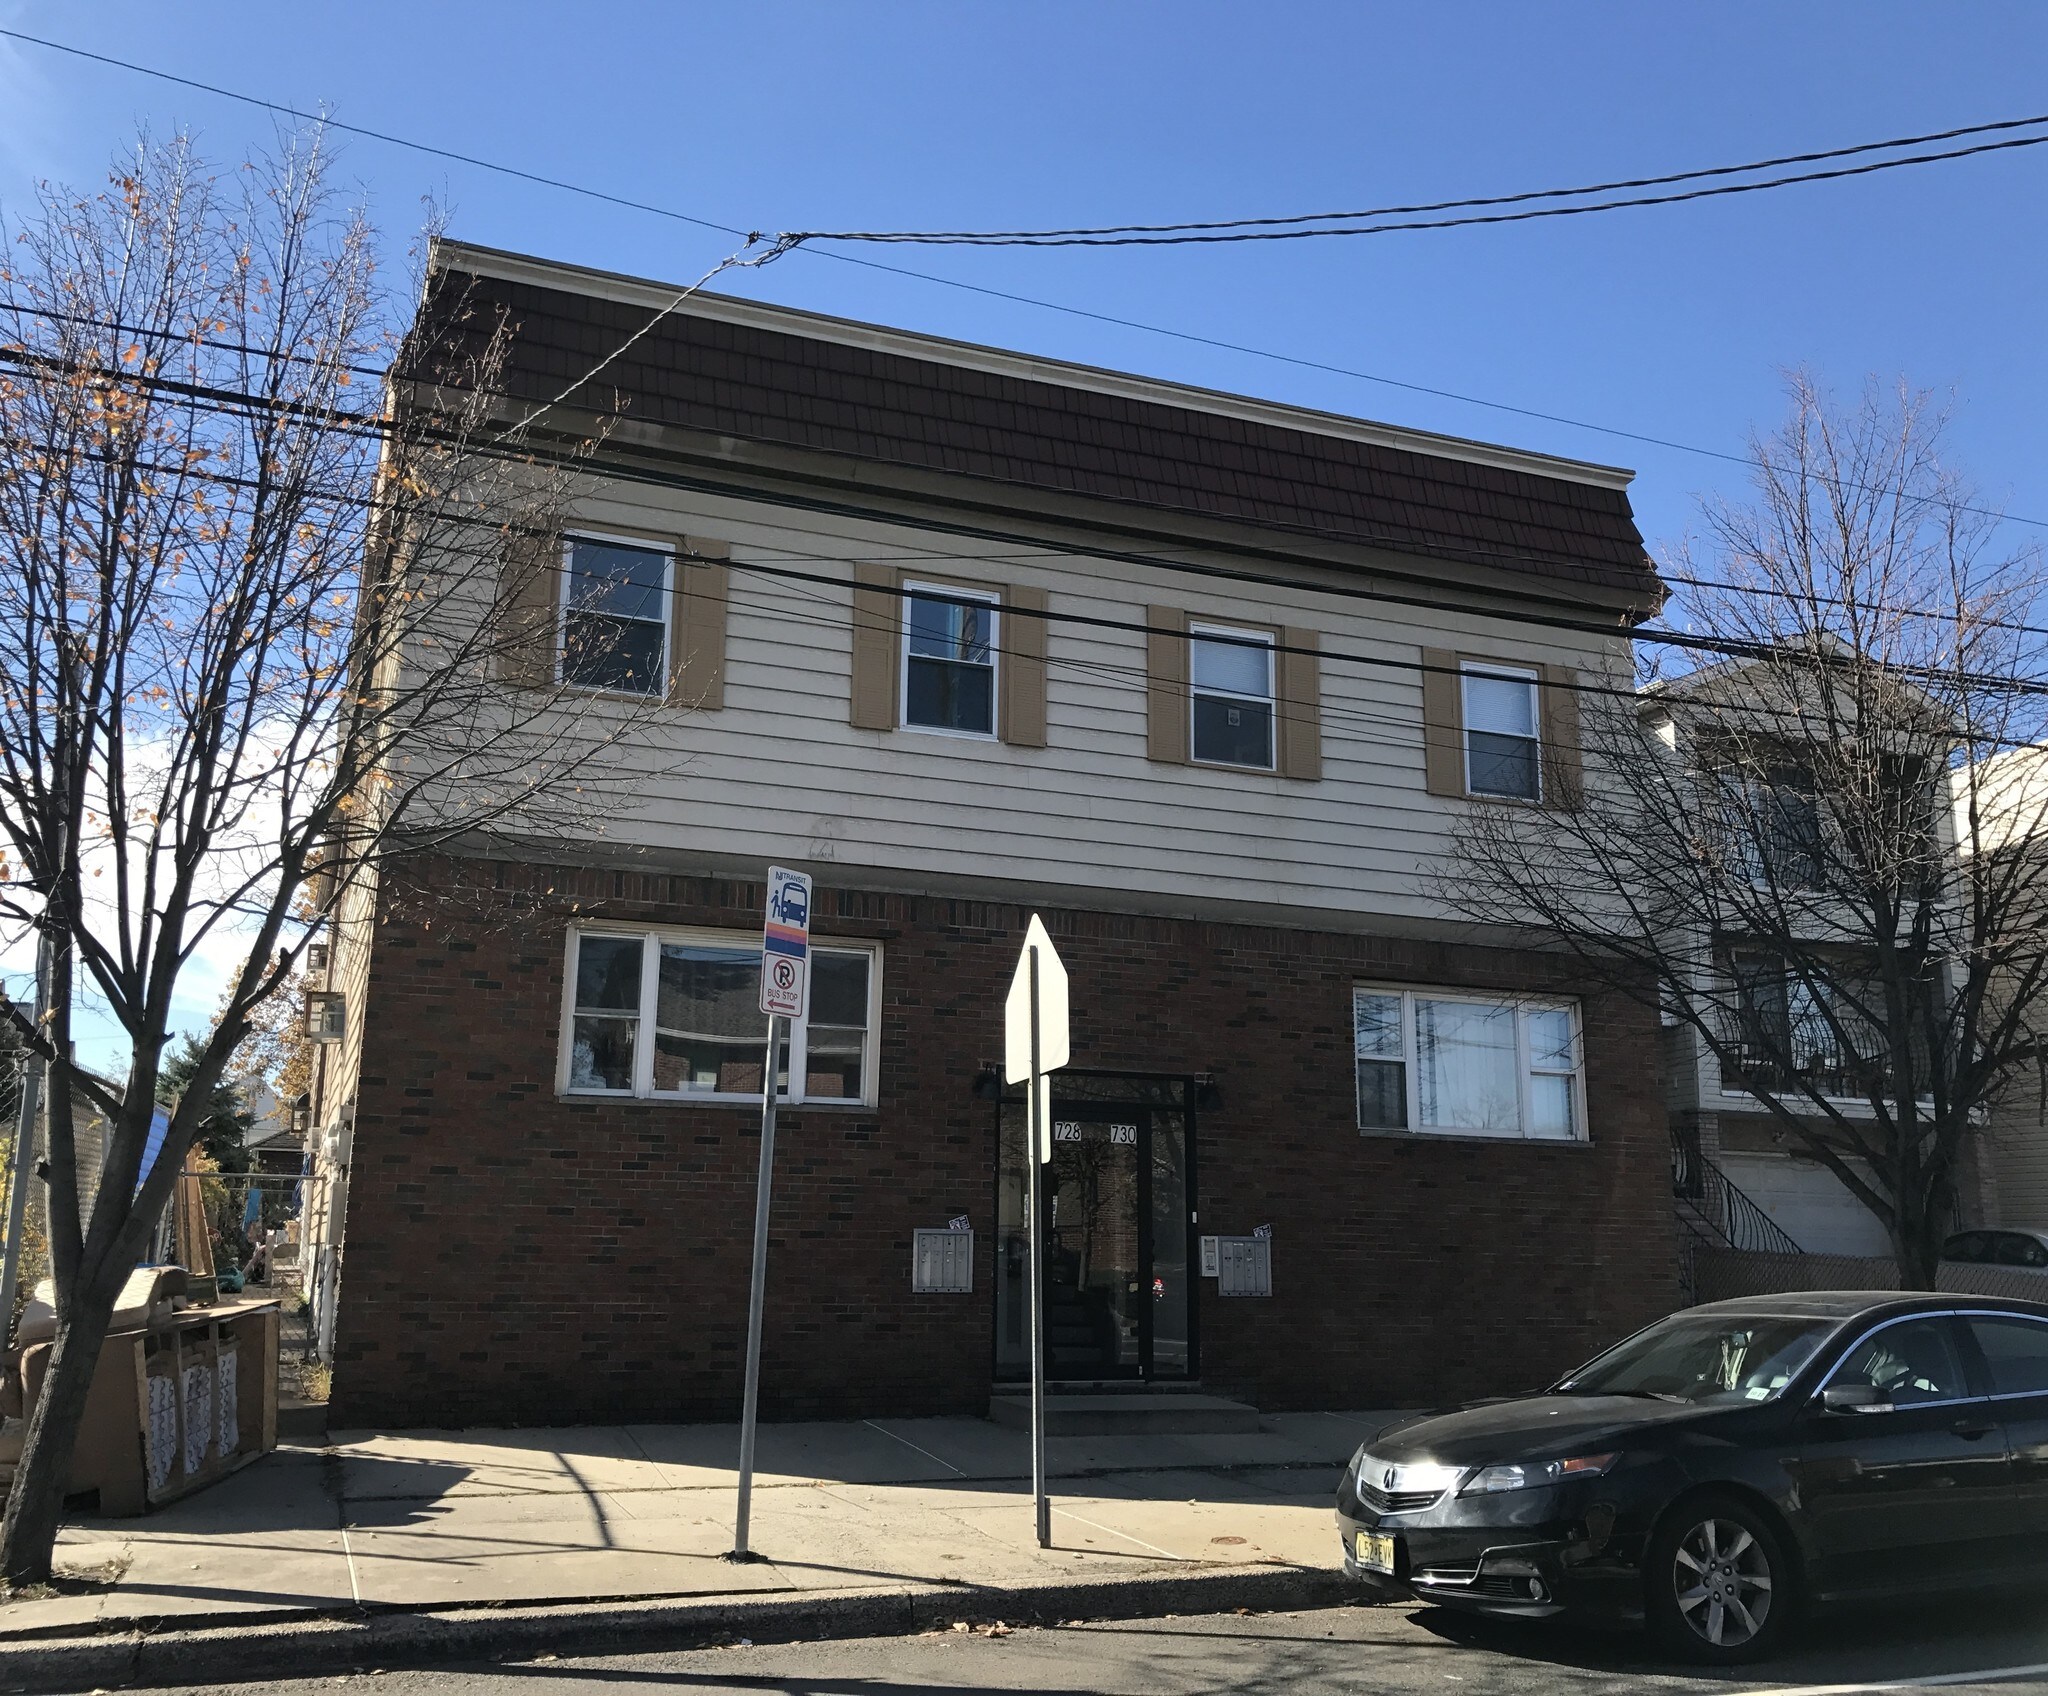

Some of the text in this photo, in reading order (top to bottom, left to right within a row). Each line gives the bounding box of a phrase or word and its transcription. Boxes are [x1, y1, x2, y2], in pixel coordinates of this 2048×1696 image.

[768, 989, 798, 1001] BUS STOP
[1056, 1122, 1136, 1143] 728 730
